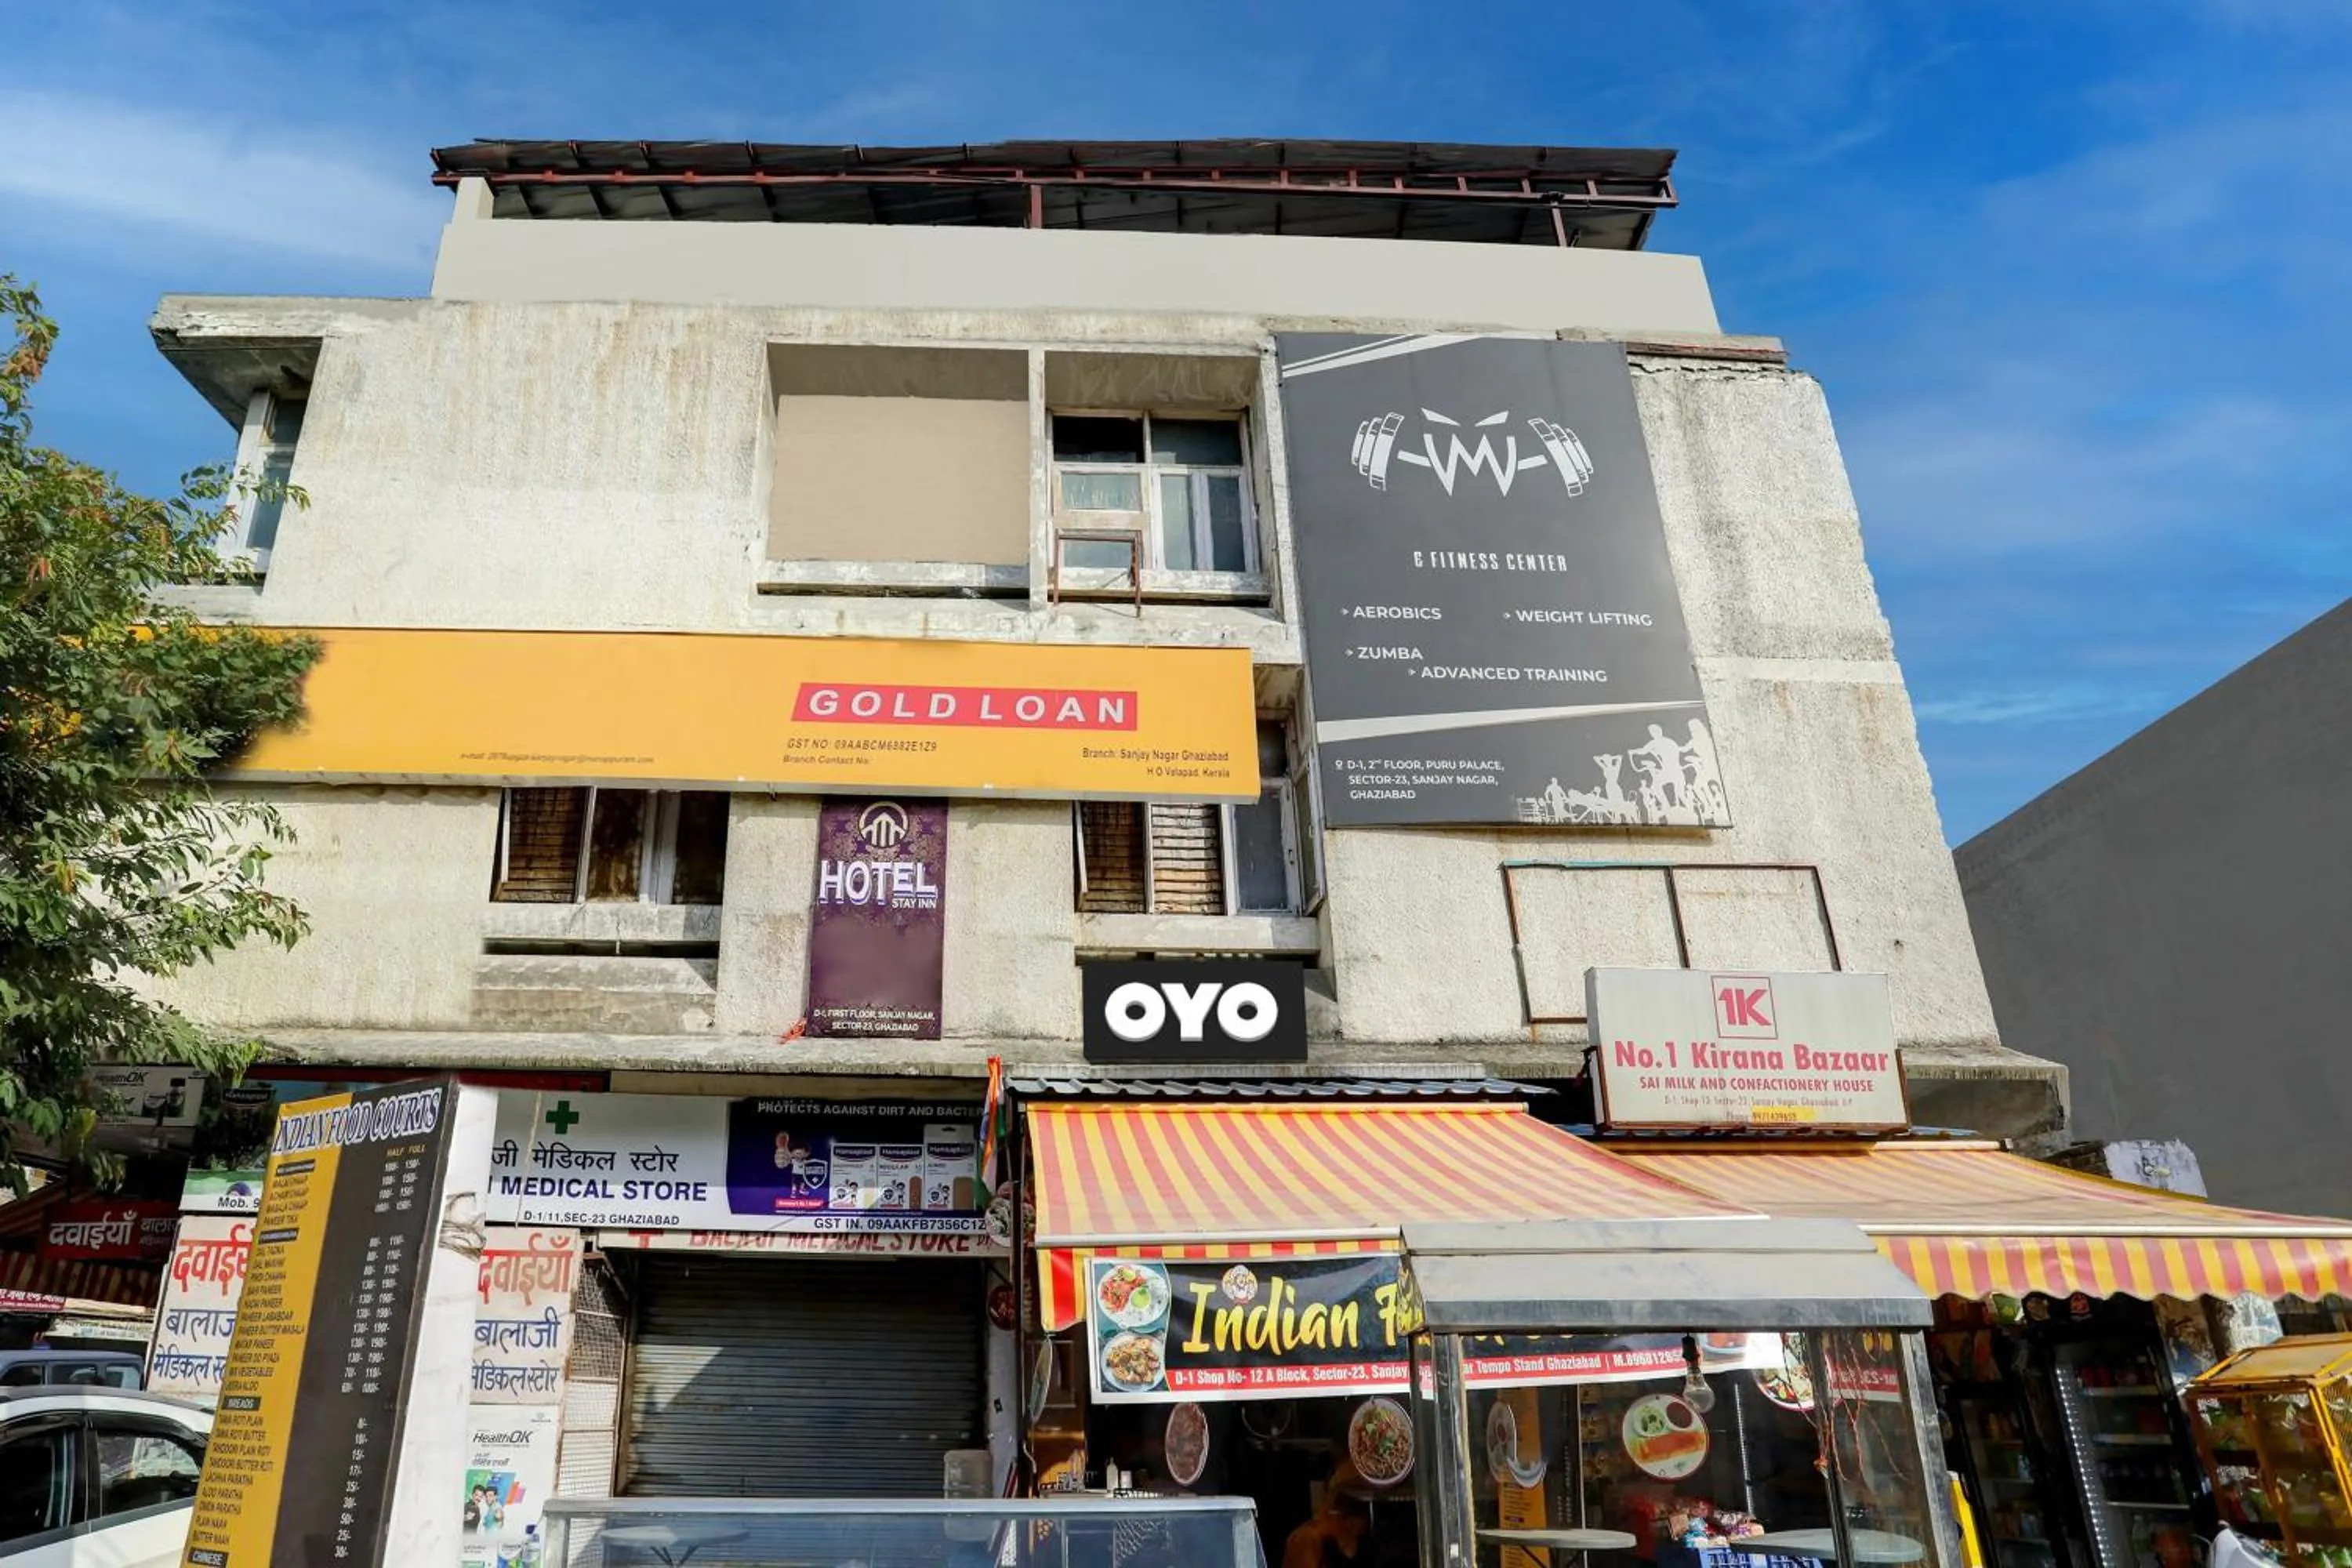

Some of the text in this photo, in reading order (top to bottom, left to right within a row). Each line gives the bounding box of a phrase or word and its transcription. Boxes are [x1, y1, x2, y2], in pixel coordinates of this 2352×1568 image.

[1430, 551, 1499, 570] FITNESS
[1505, 554, 1567, 572] CENTER
[1353, 606, 1442, 620] AEROBICS
[1515, 610, 1653, 626] WEIGHT LIFTING
[1357, 647, 1423, 660] ZUMBA
[1421, 666, 1607, 682] ADVANCED TRAINING
[808, 689, 1124, 724] GOLD LOAN
[787, 739, 809, 750] GST
[783, 755, 816, 764] Branch
[818, 756, 854, 765] Contact
[1120, 749, 1150, 762] Sanjay
[1152, 750, 1179, 763] Nagar
[1181, 750, 1229, 761] Ghaziabad
[1203, 768, 1230, 778] Kerala
[1384, 760, 1424, 771] FLOOR,
[1426, 760, 1456, 770] PURU
[1460, 760, 1504, 771] PALACE,
[1348, 775, 1498, 786] SECTOR-23, SANJAY NAGAR,
[1350, 789, 1417, 800] GHAZIABAD
[818, 860, 938, 906] HOTEL
[891, 898, 937, 909] STAY INN
[827, 1008, 849, 1018] FIRST
[877, 1011, 906, 1020] SANJAY
[1105, 982, 1279, 1042] OYO
[1719, 988, 1772, 1026] 1K
[1614, 1040, 1889, 1072] No.1 Kirana Bazaar
[1639, 1076, 1875, 1092] SAI MILK AND CONFACTIONERY HOUSE
[757, 1101, 985, 1118] PROTECTS AGAINST DIRT AND BACTER
[271, 1087, 443, 1155] INDIAN FOOD COURTS
[532, 1142, 616, 1171] मेडिकल
[629, 1145, 680, 1173] स्टोर
[501, 1176, 615, 1199] MEDICAL
[622, 1181, 708, 1202] STORE
[217, 1196, 249, 1209] Mob.
[609, 1214, 680, 1226] GHAZIABAD
[814, 1218, 842, 1229] GST
[868, 1219, 986, 1231] 09AAKFB7356C1Z
[477, 1232, 575, 1306] दवाईयाँ
[1182, 1276, 1359, 1356] Indian
[165, 1308, 237, 1343] बालाज
[474, 1306, 561, 1354] बालाजी
[153, 1343, 212, 1387] मेडिकल
[1175, 1371, 1194, 1385] D-1
[1197, 1369, 1224, 1385] Shop
[1250, 1369, 1264, 1383] 12
[1266, 1369, 1275, 1382] A
[1276, 1368, 1311, 1383] Block,
[1313, 1366, 1368, 1381] Sector-23,
[1372, 1364, 1408, 1382] Sanjay
[1477, 1360, 1511, 1374] Tempo
[1514, 1359, 1544, 1372] Stand
[1547, 1355, 1601, 1371] Ghaziabad
[473, 1430, 534, 1443] HealthOK
